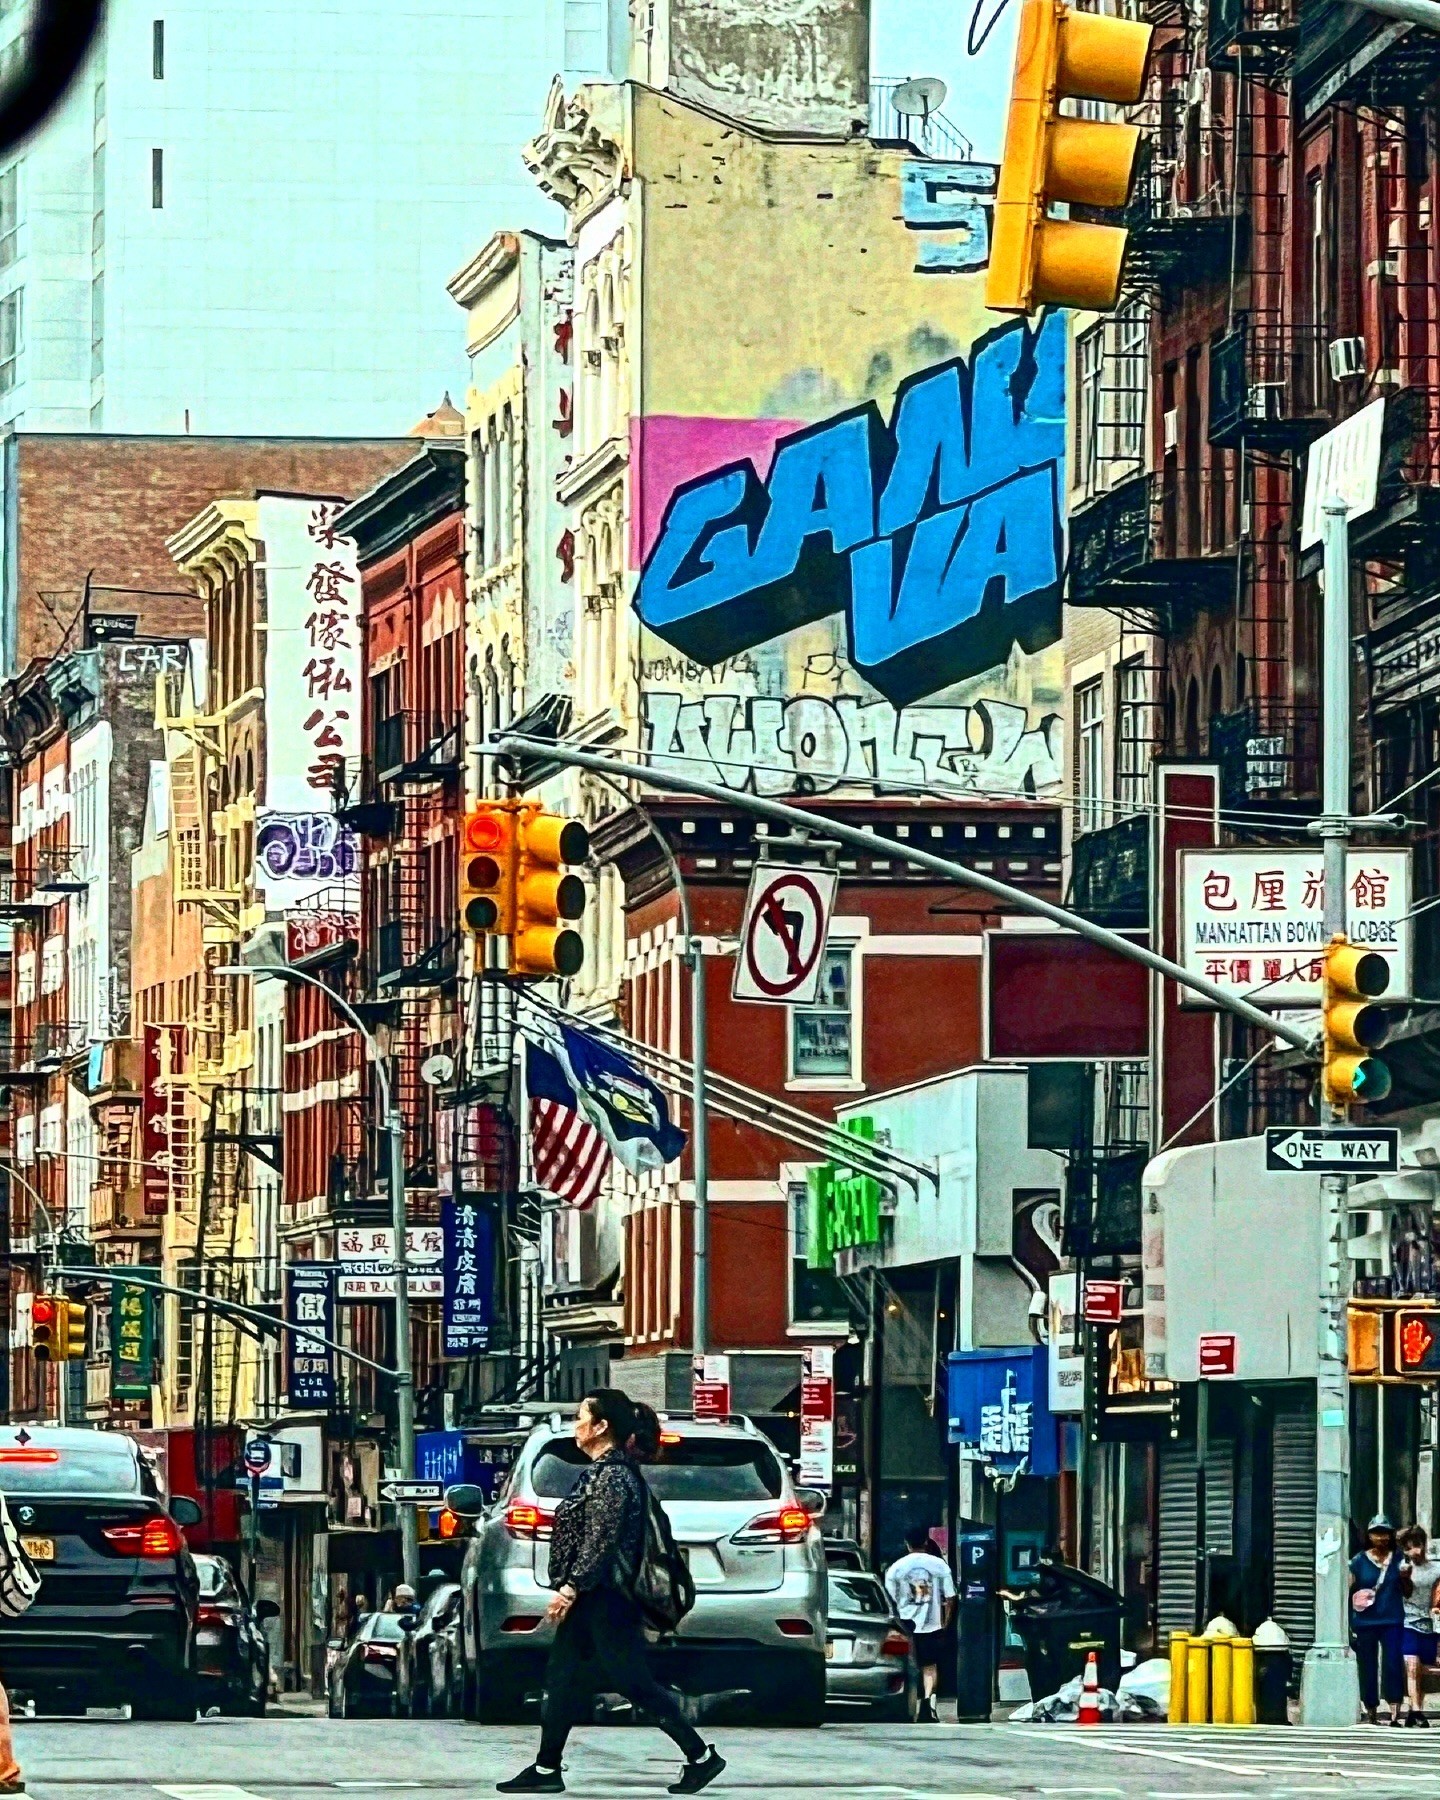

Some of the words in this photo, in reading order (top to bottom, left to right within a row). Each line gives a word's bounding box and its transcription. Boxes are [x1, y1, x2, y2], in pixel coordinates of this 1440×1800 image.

[1195, 921, 1281, 944] MANHATTAN
[1351, 919, 1398, 942] LODGE
[1286, 1142, 1323, 1159] ONE
[1341, 1142, 1381, 1160] WAY
